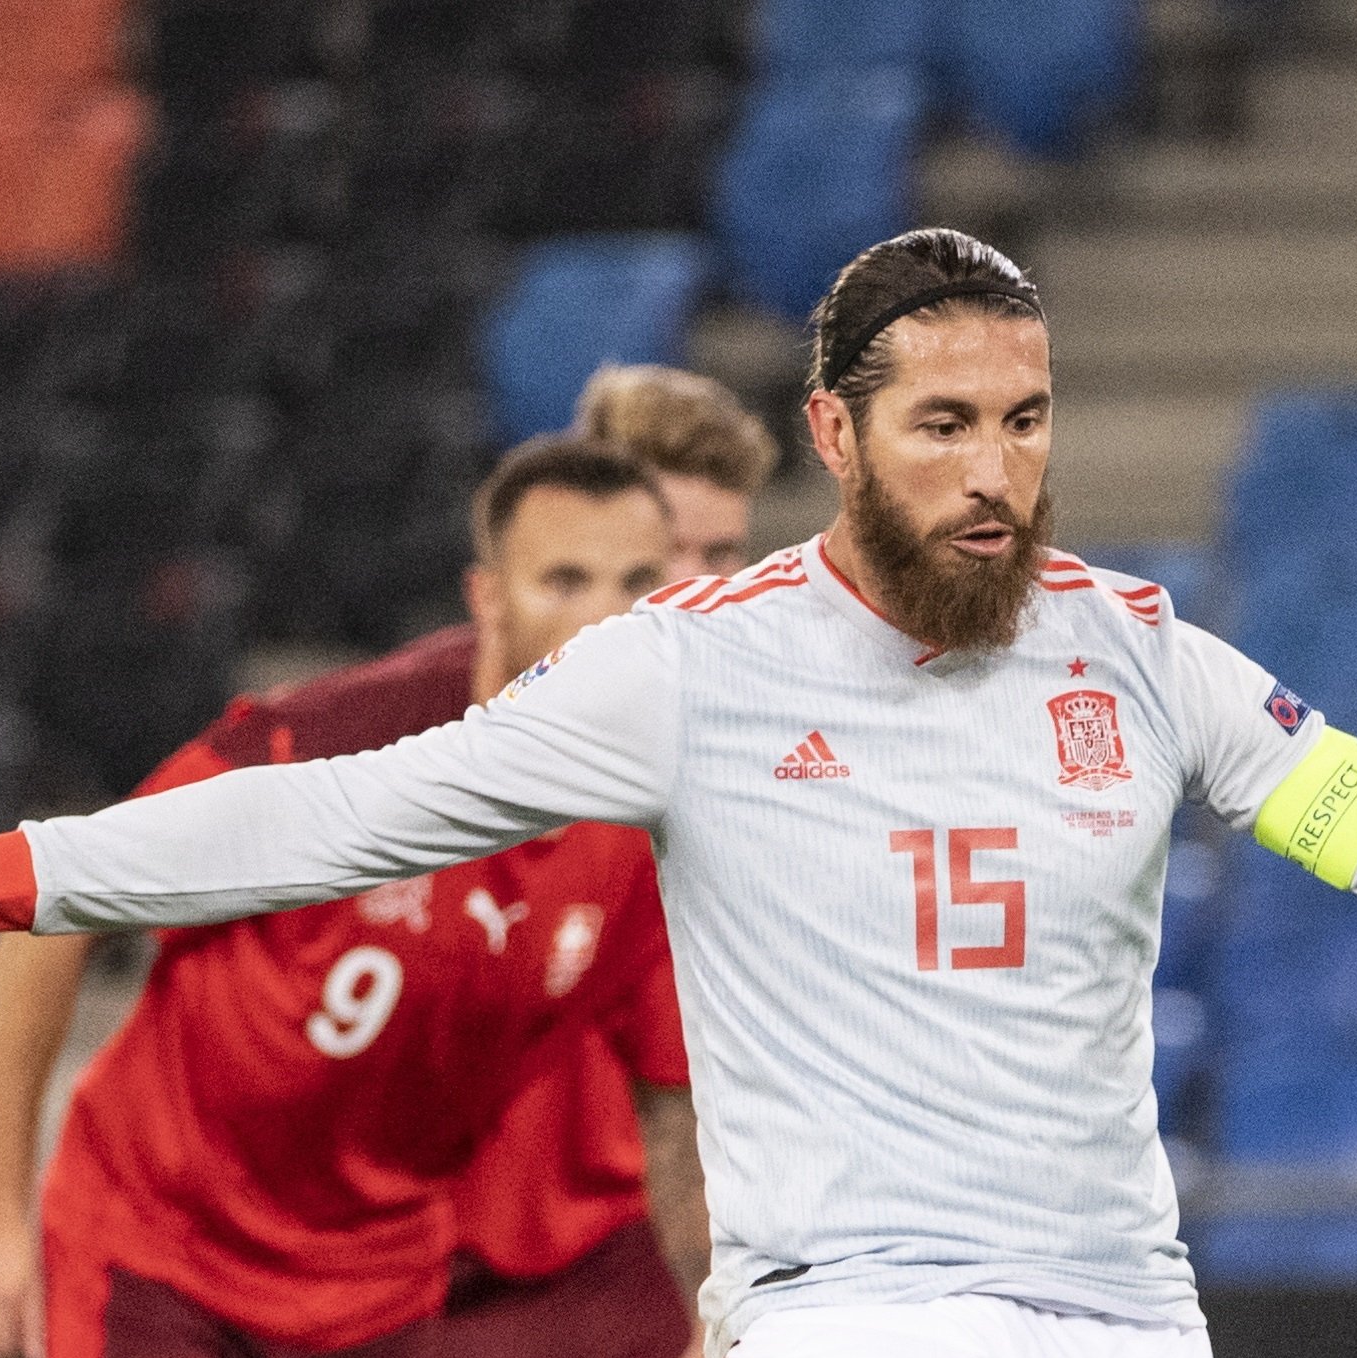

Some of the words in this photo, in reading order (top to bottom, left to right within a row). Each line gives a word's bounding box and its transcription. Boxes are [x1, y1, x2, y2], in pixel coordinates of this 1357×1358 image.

[774, 761, 850, 780] adidas
[889, 826, 1027, 971] 15
[306, 945, 404, 1060] 9
